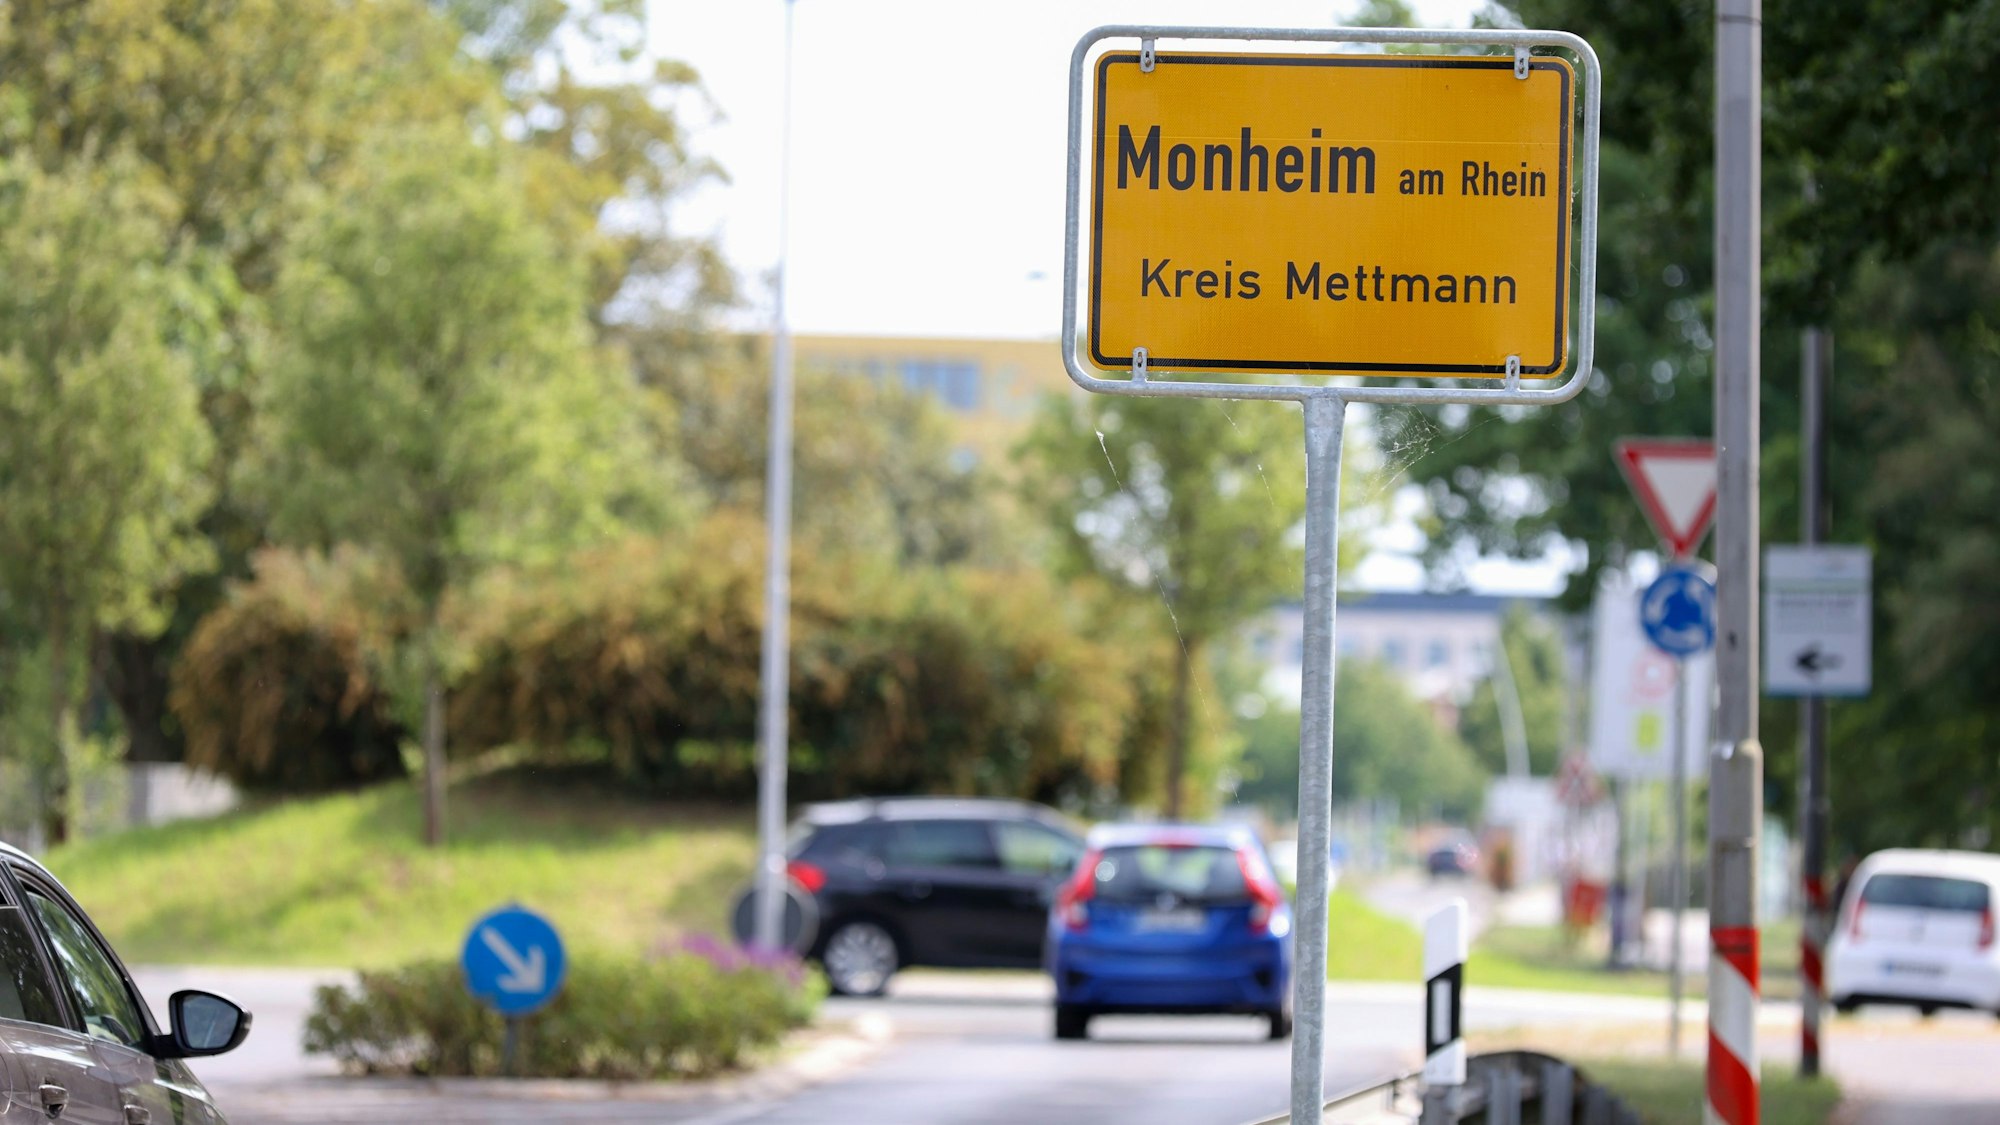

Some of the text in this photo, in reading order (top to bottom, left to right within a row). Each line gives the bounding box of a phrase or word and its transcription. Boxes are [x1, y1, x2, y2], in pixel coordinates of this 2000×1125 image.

[1117, 124, 1546, 197] Monheim am Rhein
[1141, 258, 1516, 304] Kreis Mettmann
